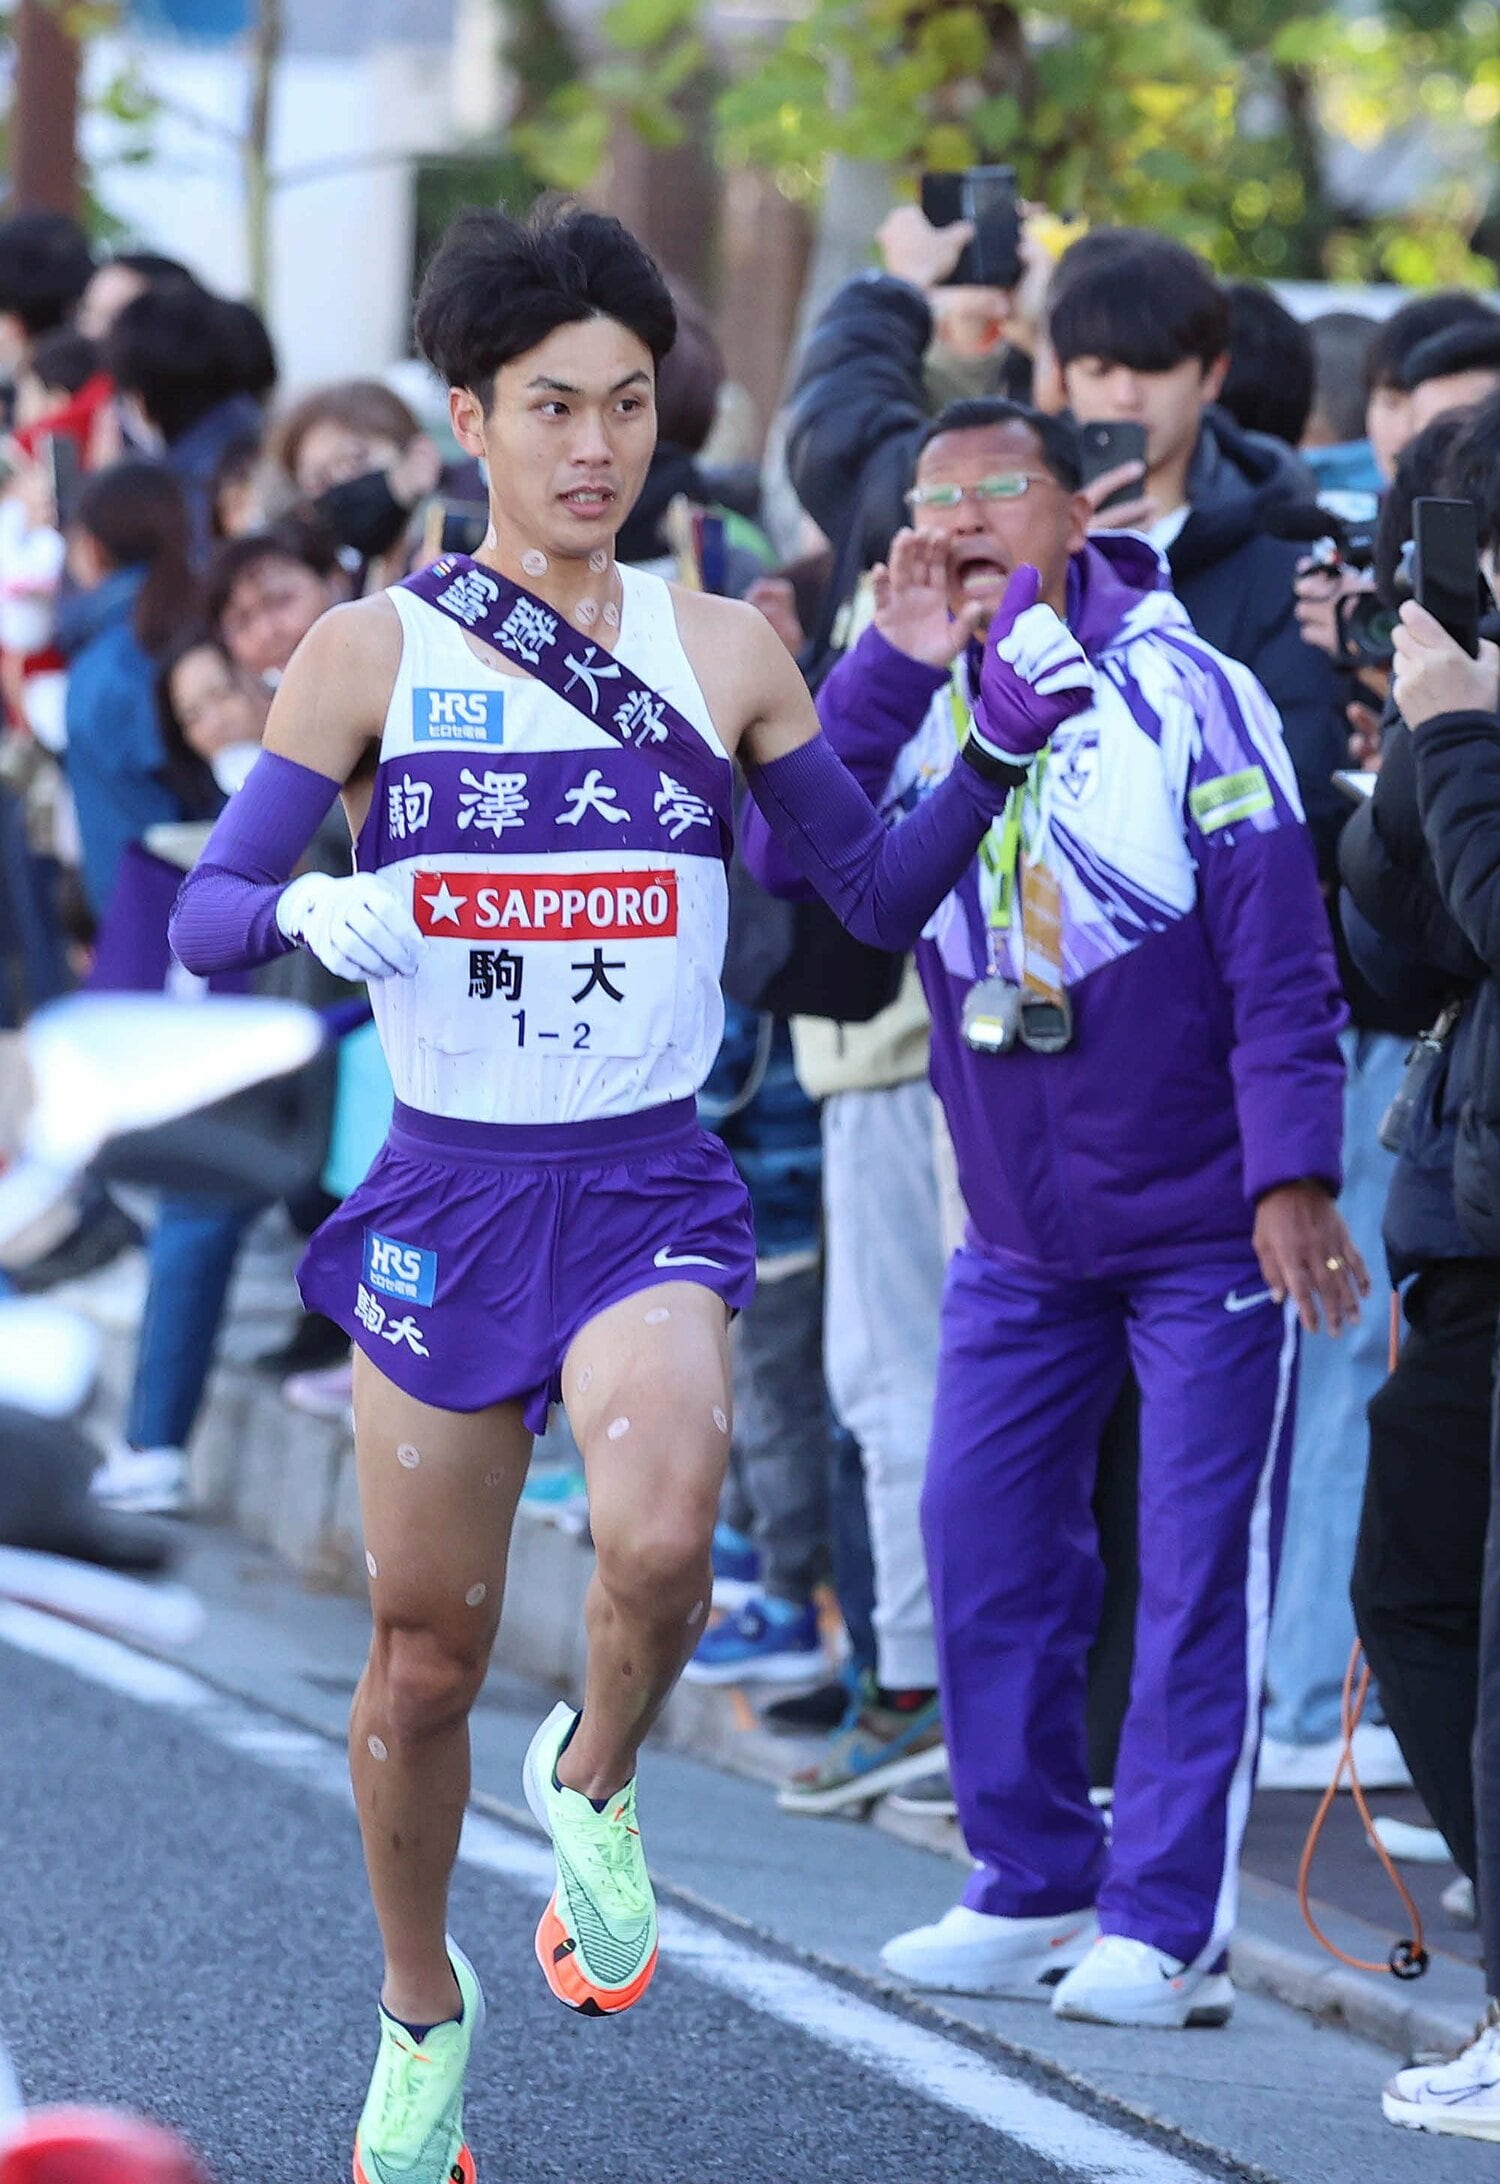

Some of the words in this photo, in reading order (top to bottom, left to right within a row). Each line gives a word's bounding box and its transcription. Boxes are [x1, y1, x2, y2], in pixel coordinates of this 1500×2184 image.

[436, 569, 669, 749] 駒澤大学
[428, 691, 488, 725] HRS
[474, 885, 669, 929] SAPPORO
[468, 946, 626, 1004] 駒大
[370, 1237, 422, 1283] HRS
[353, 1282, 430, 1358] 駒大
